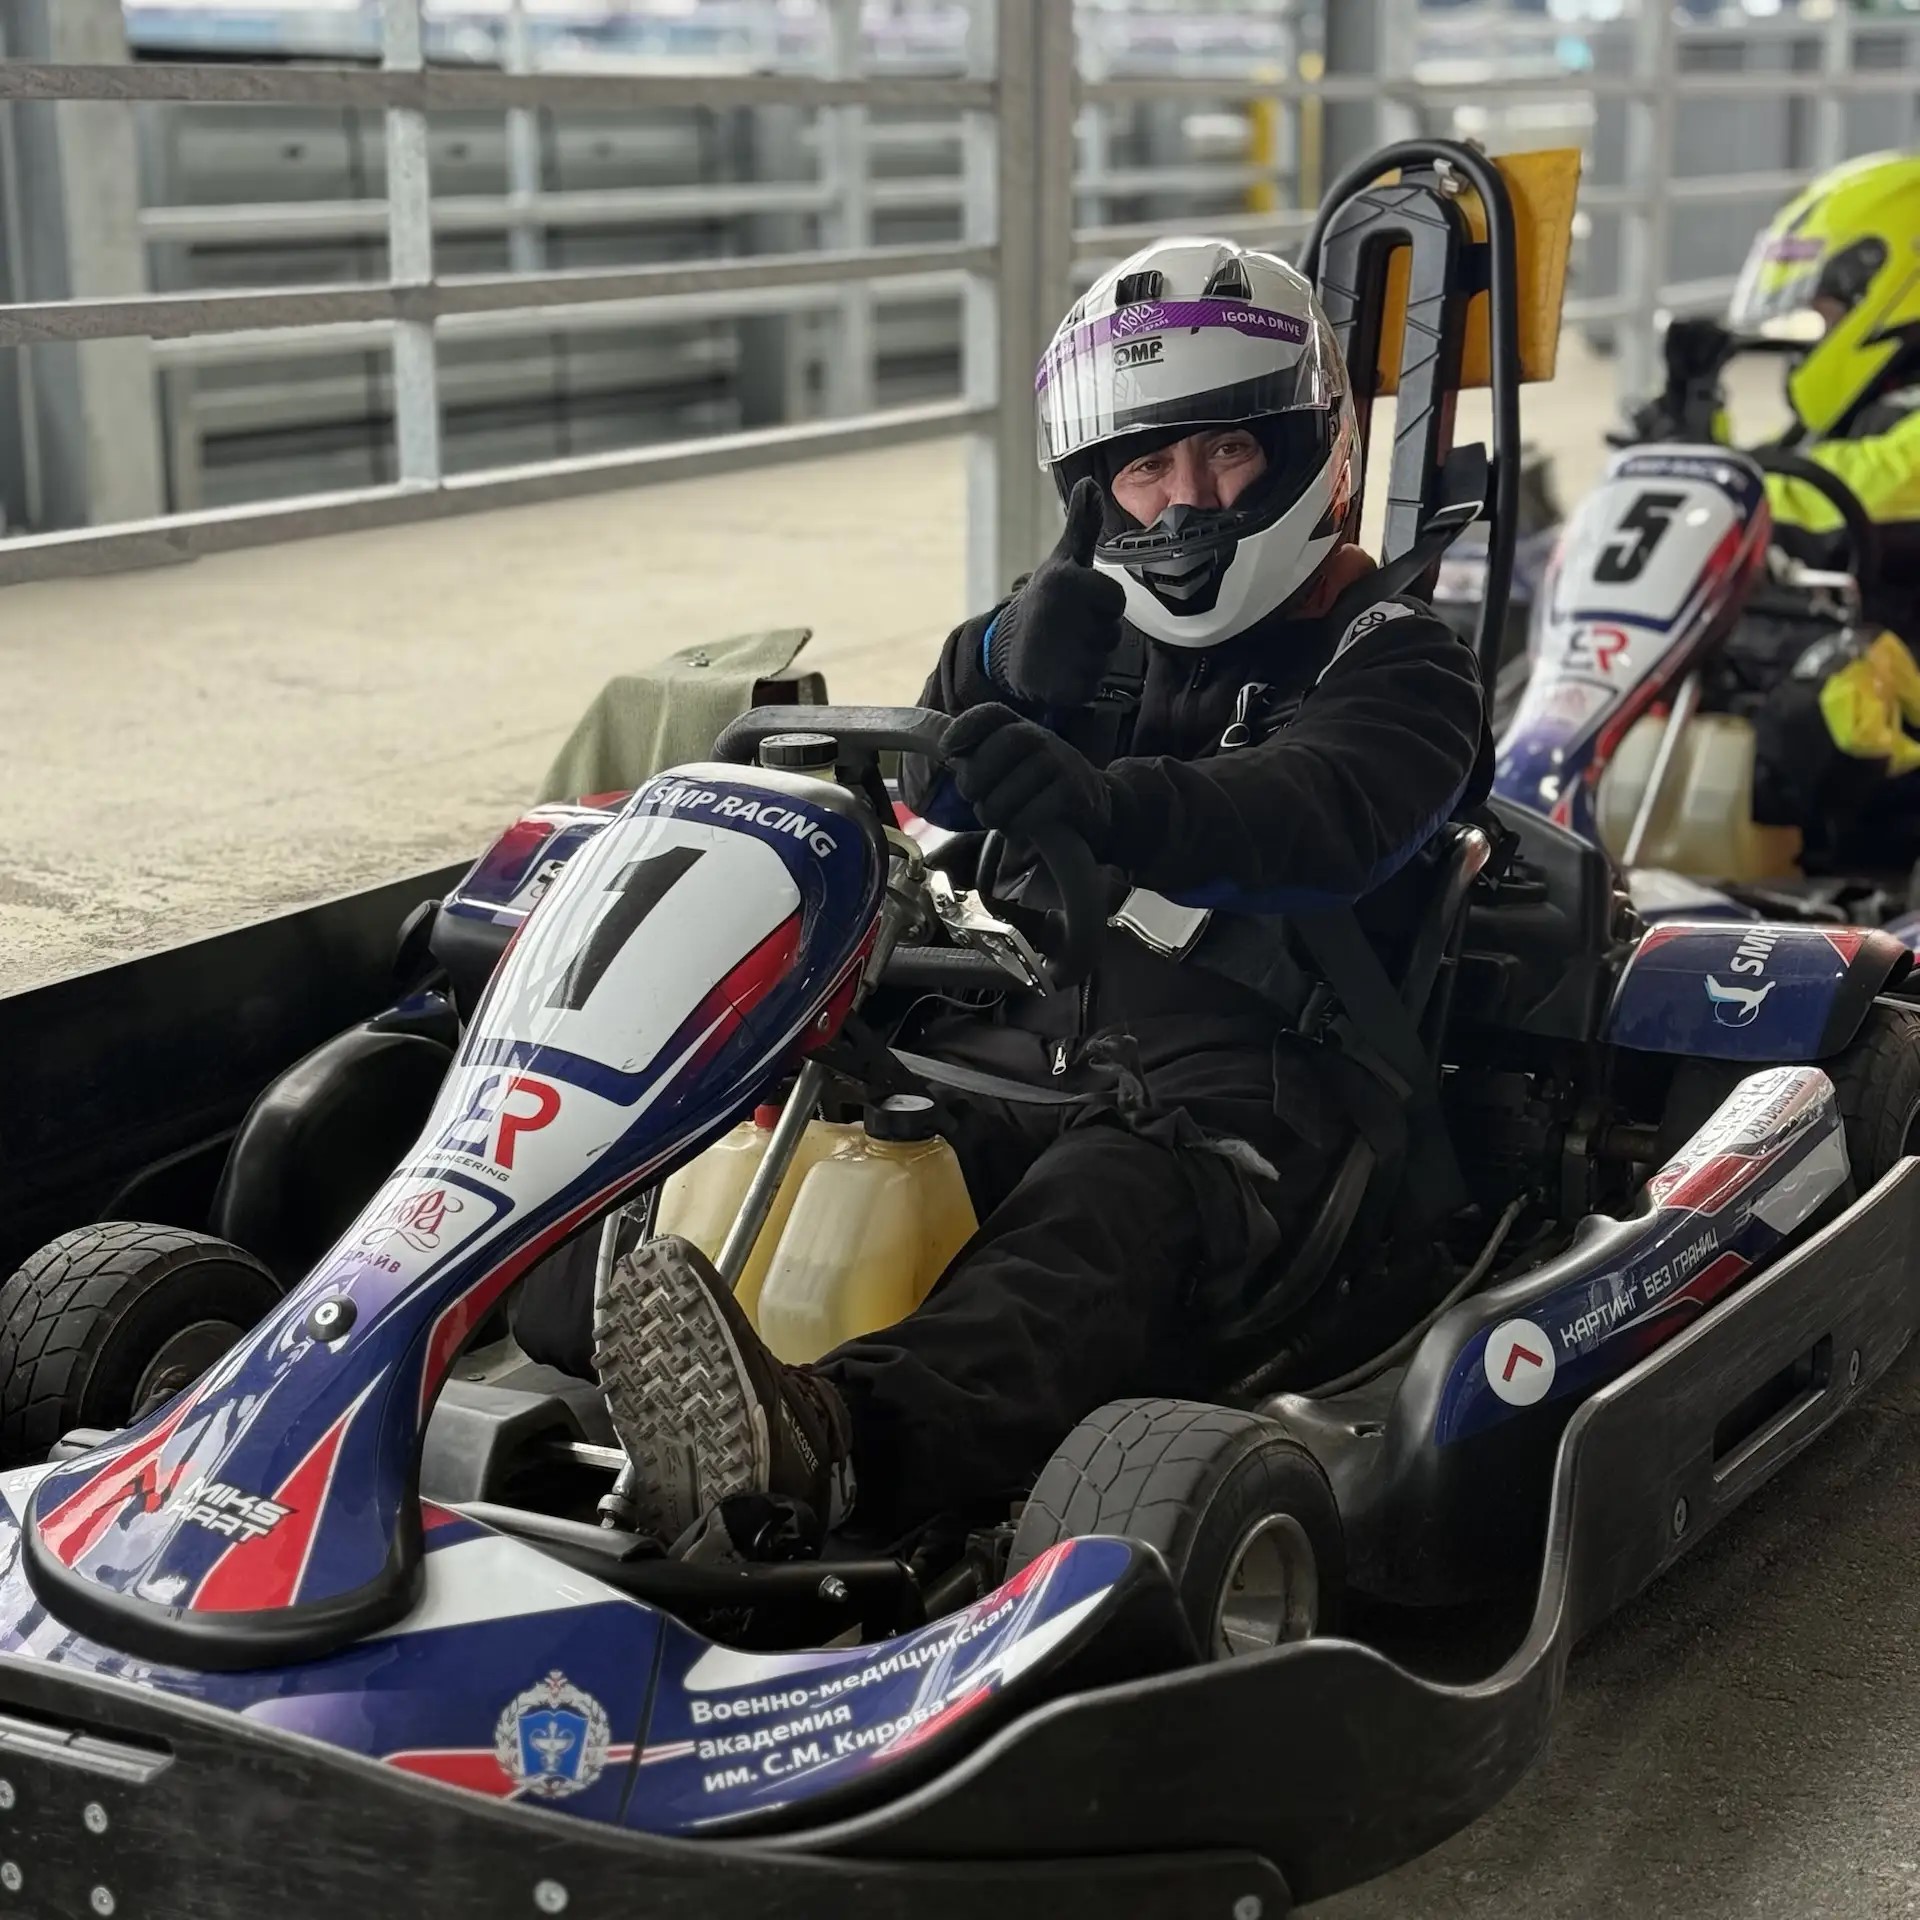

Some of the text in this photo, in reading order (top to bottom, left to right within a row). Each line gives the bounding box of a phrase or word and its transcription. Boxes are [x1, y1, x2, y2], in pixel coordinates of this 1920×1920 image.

[1113, 340, 1164, 367] OMP
[1221, 311, 1302, 336] IGORA DRIVE
[1592, 490, 1688, 584] 5
[645, 785, 838, 859] SMP RACING
[544, 845, 708, 1012] 1
[1559, 1227, 1720, 1349] КАРТИНГ БЕЗ ГРАНИЦ
[164, 1498, 270, 1542] KART
[184, 1477, 292, 1526] MIKS
[690, 1598, 1014, 1724] Военно-медицинская
[698, 1703, 852, 1759] академия
[703, 1701, 947, 1793] им. С.М. Кирова
